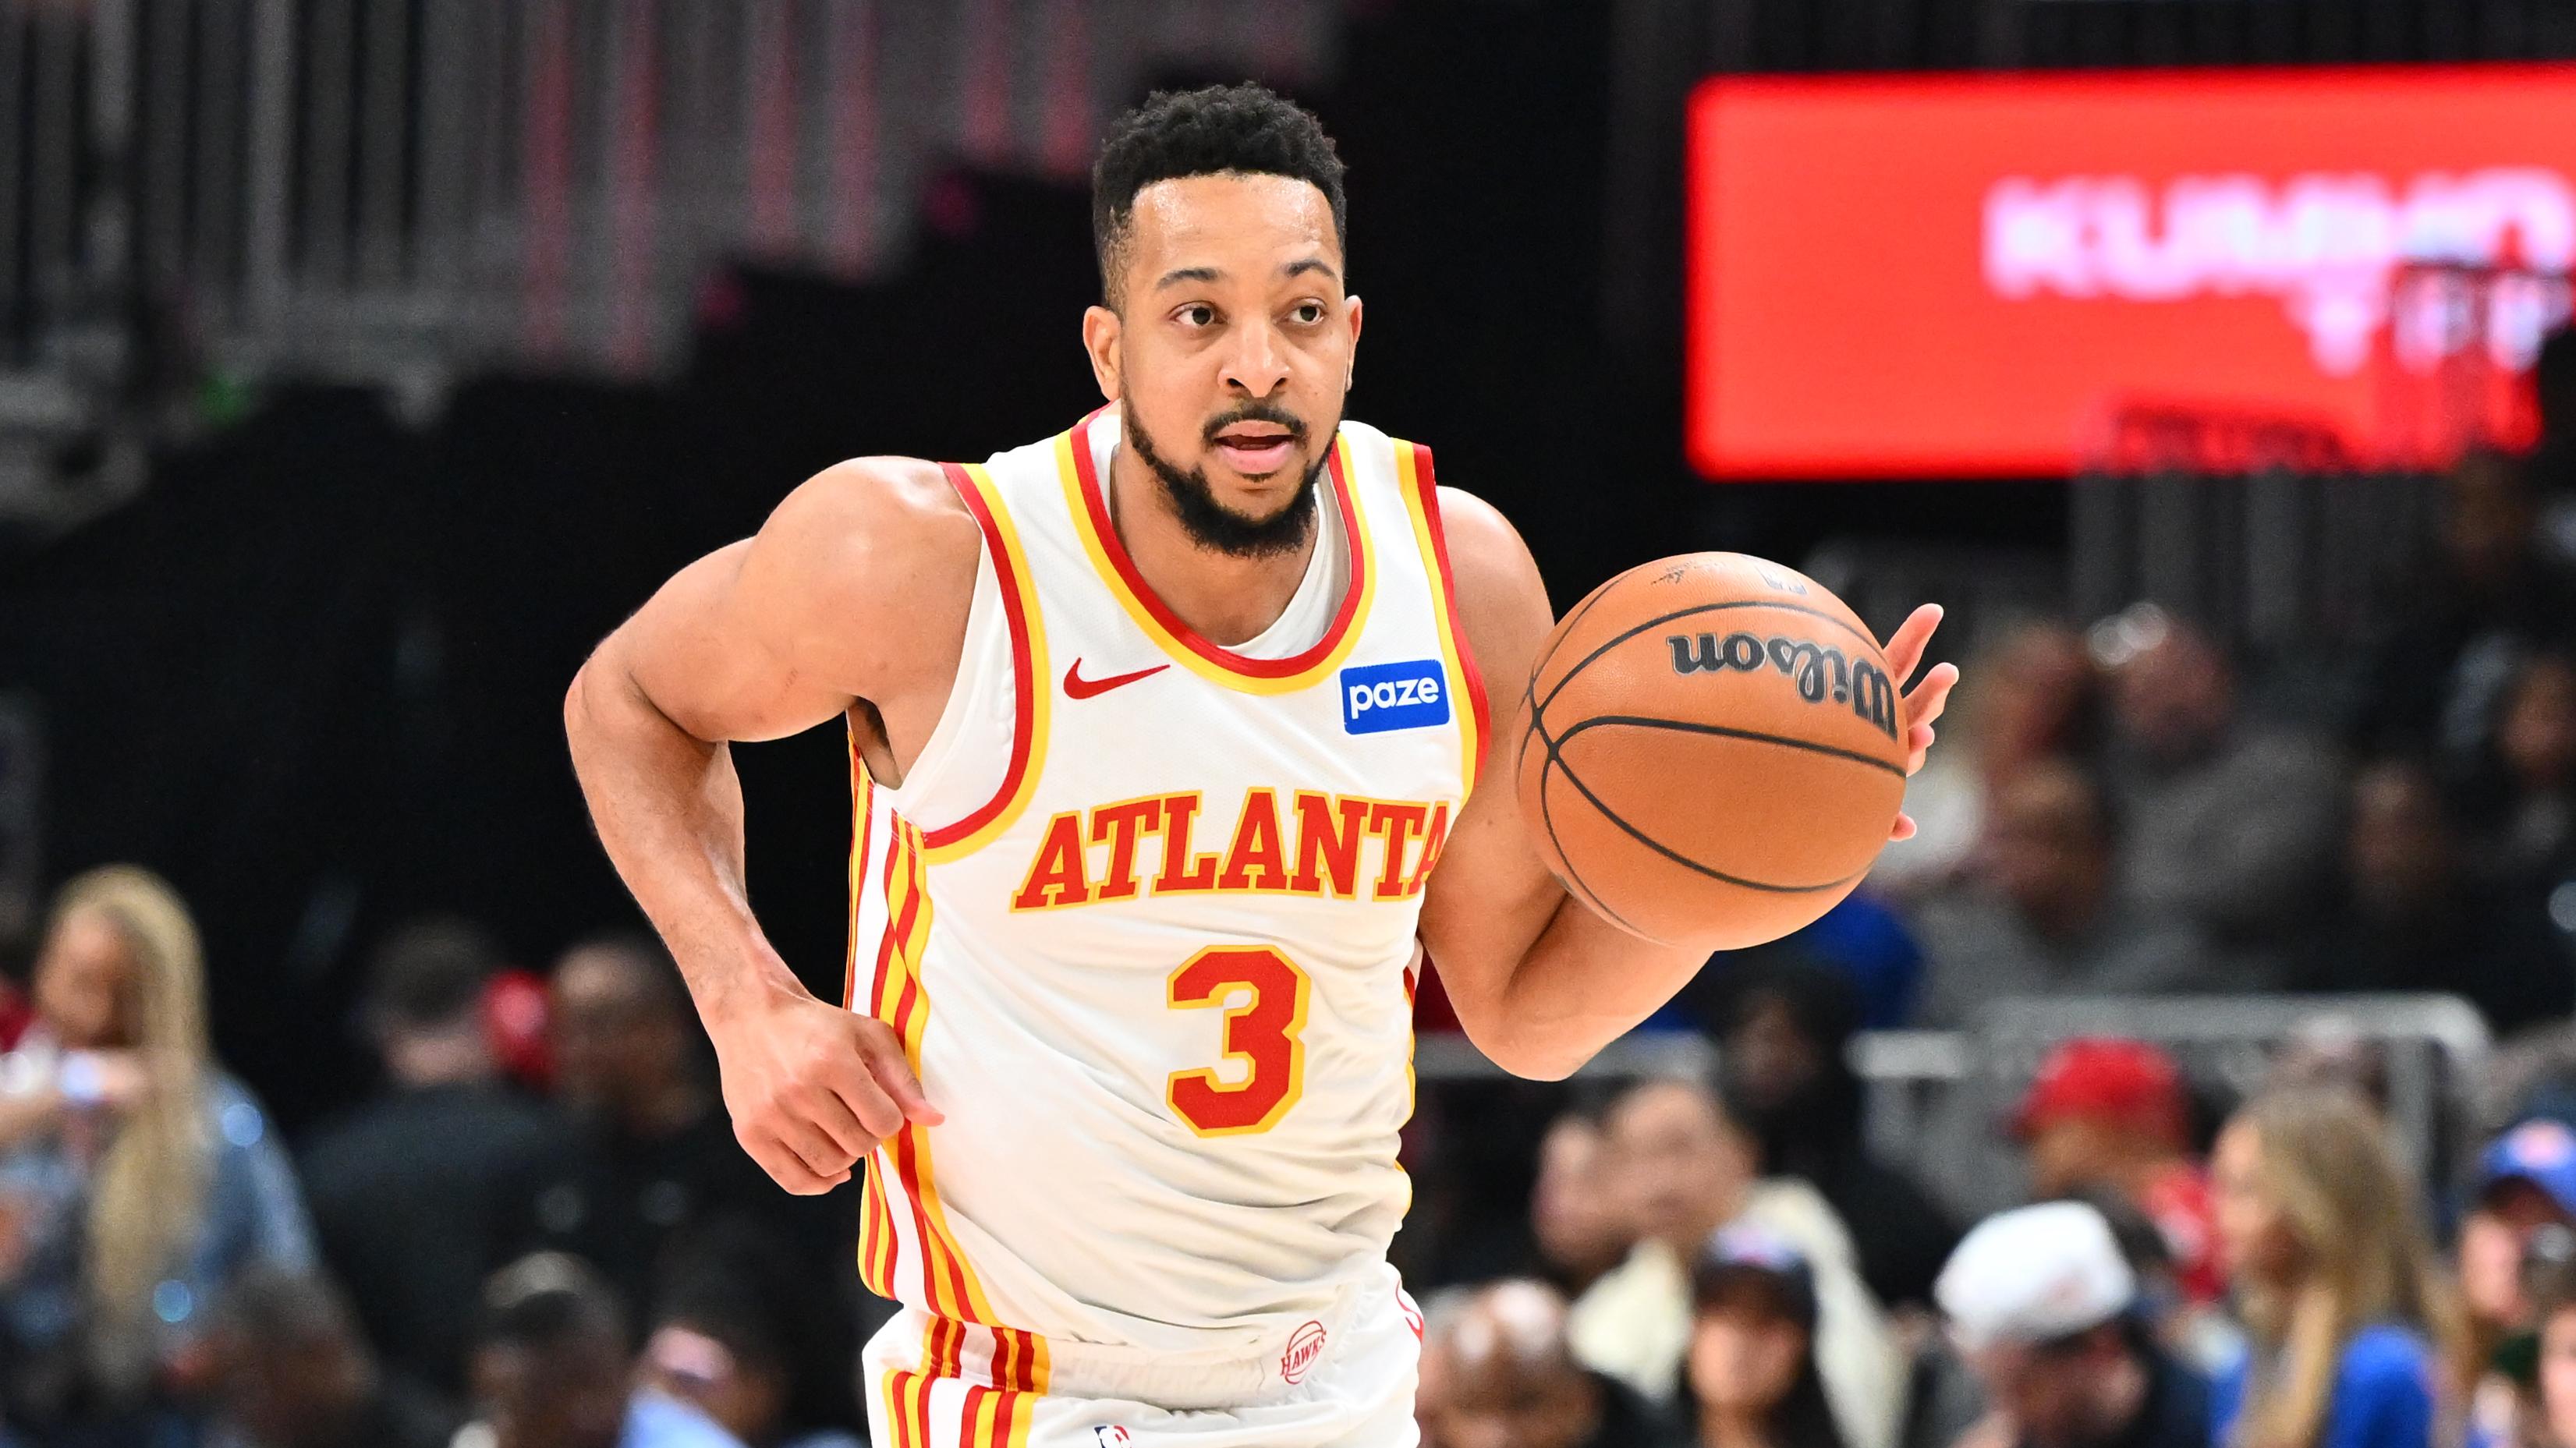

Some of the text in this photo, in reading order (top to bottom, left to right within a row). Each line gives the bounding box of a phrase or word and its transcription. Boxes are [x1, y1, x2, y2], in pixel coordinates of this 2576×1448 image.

[1349, 677, 1440, 720] paze
[1667, 631, 1897, 745] Wilson
[1009, 786, 1449, 912] ATLANTA
[1167, 945, 1311, 1138] 3
